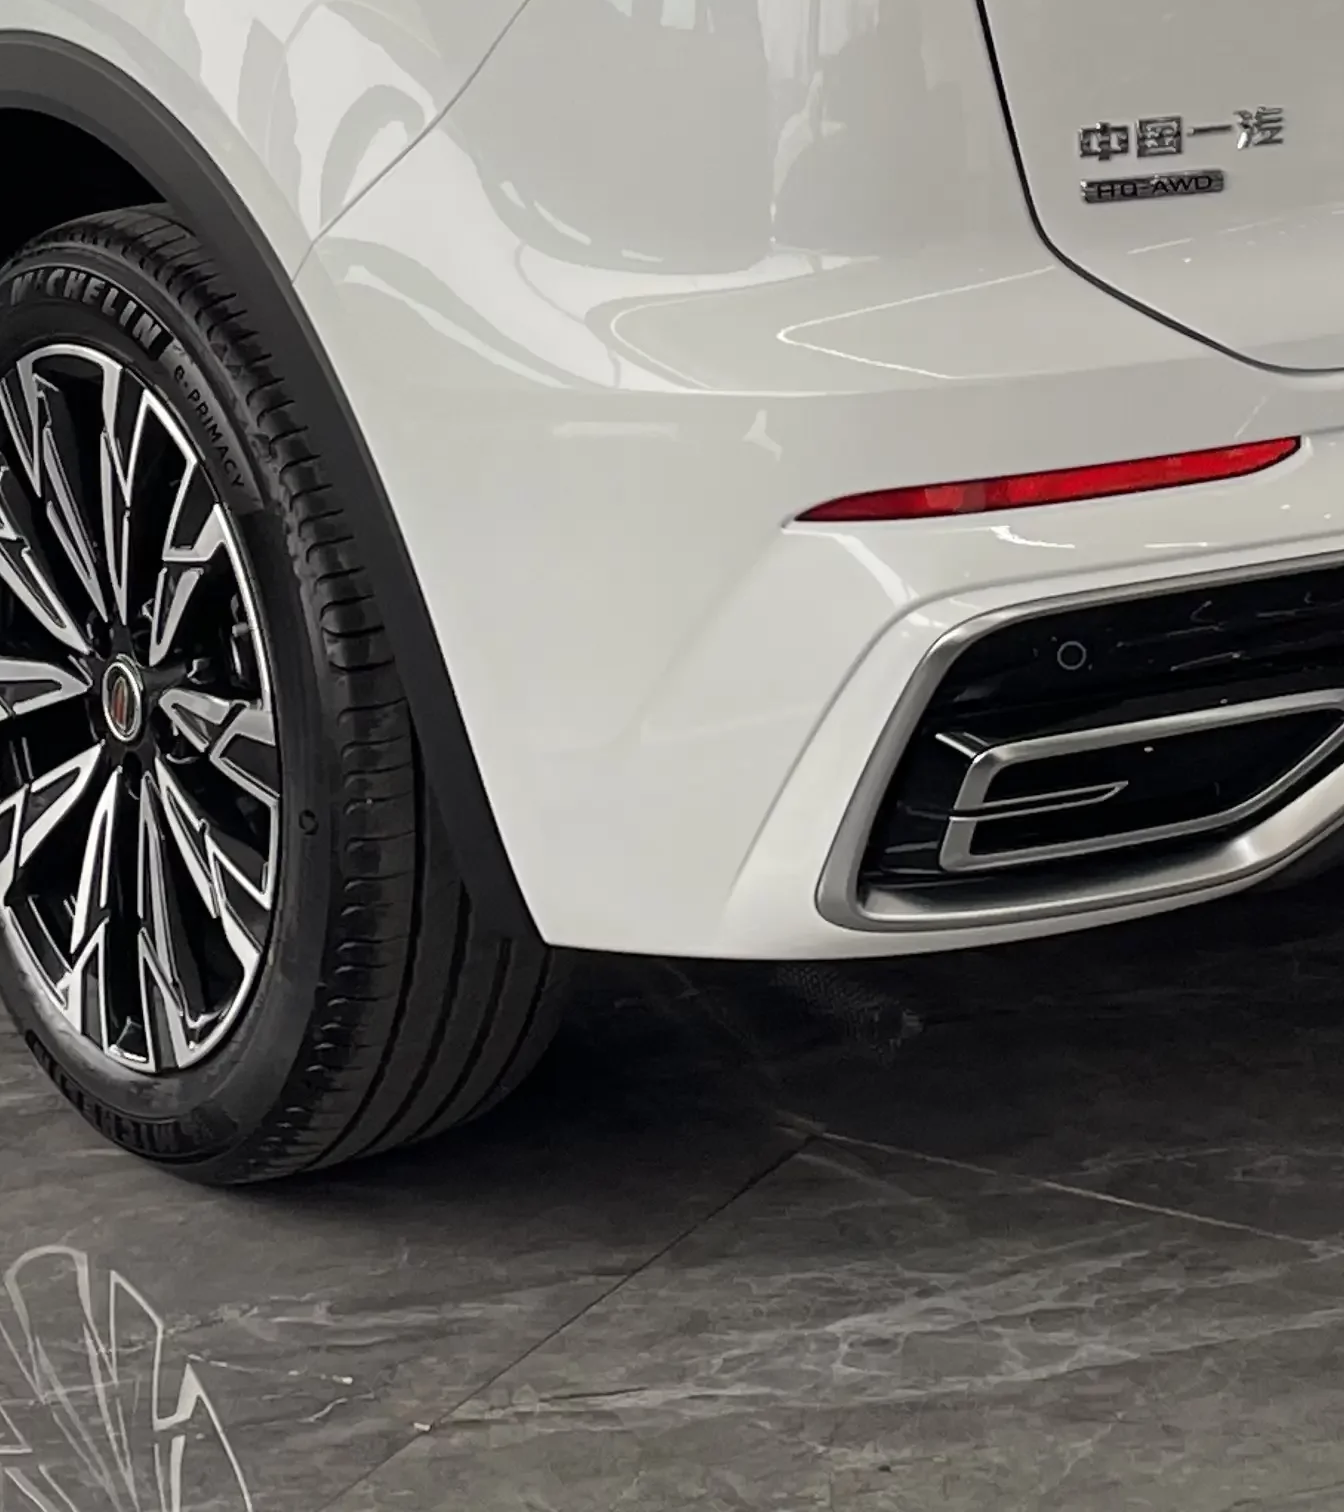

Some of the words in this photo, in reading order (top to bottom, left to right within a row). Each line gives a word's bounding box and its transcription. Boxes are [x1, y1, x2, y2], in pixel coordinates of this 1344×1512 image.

[1078, 105, 1284, 161] 中国一汽
[10, 268, 161, 350] MICHELIN
